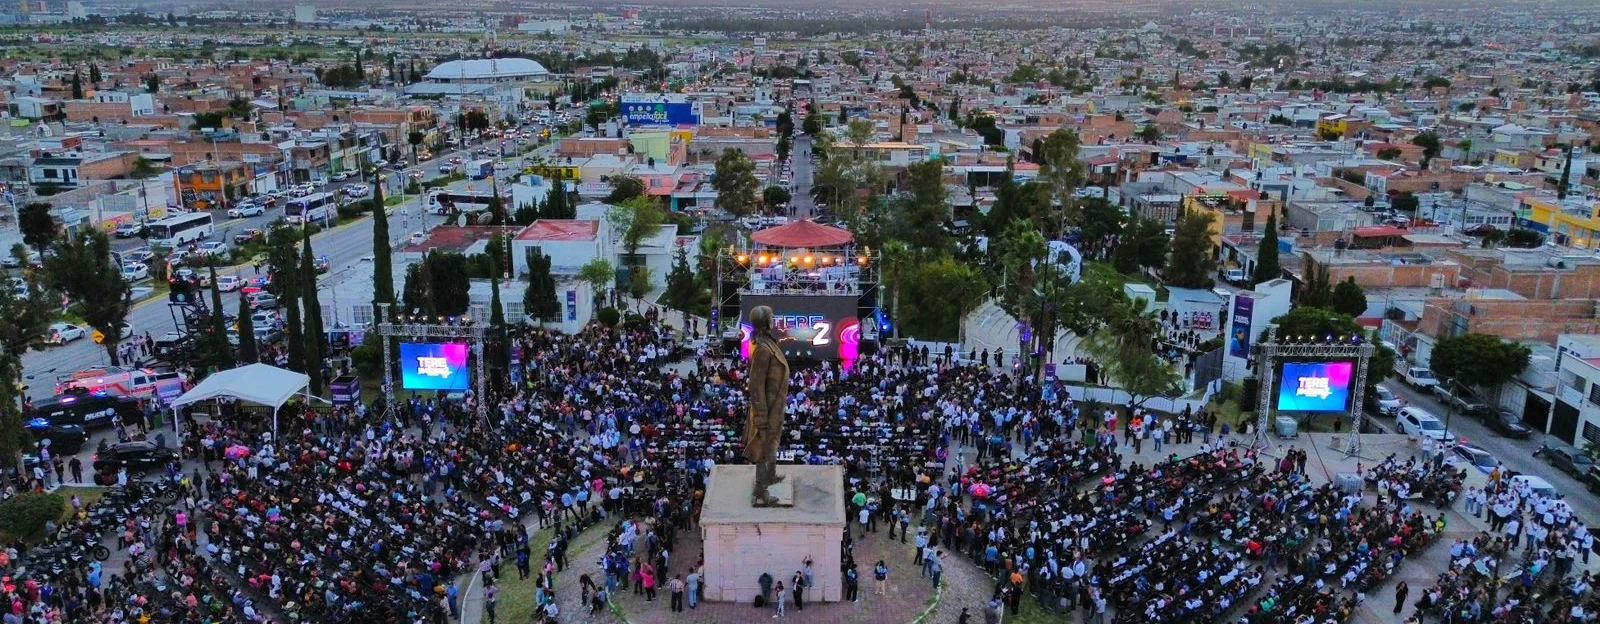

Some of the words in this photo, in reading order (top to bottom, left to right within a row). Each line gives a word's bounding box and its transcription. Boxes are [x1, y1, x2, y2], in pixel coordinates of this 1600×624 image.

[812, 322, 830, 346] 2
[417, 357, 447, 368] TERE
[1298, 377, 1330, 388] TERE
